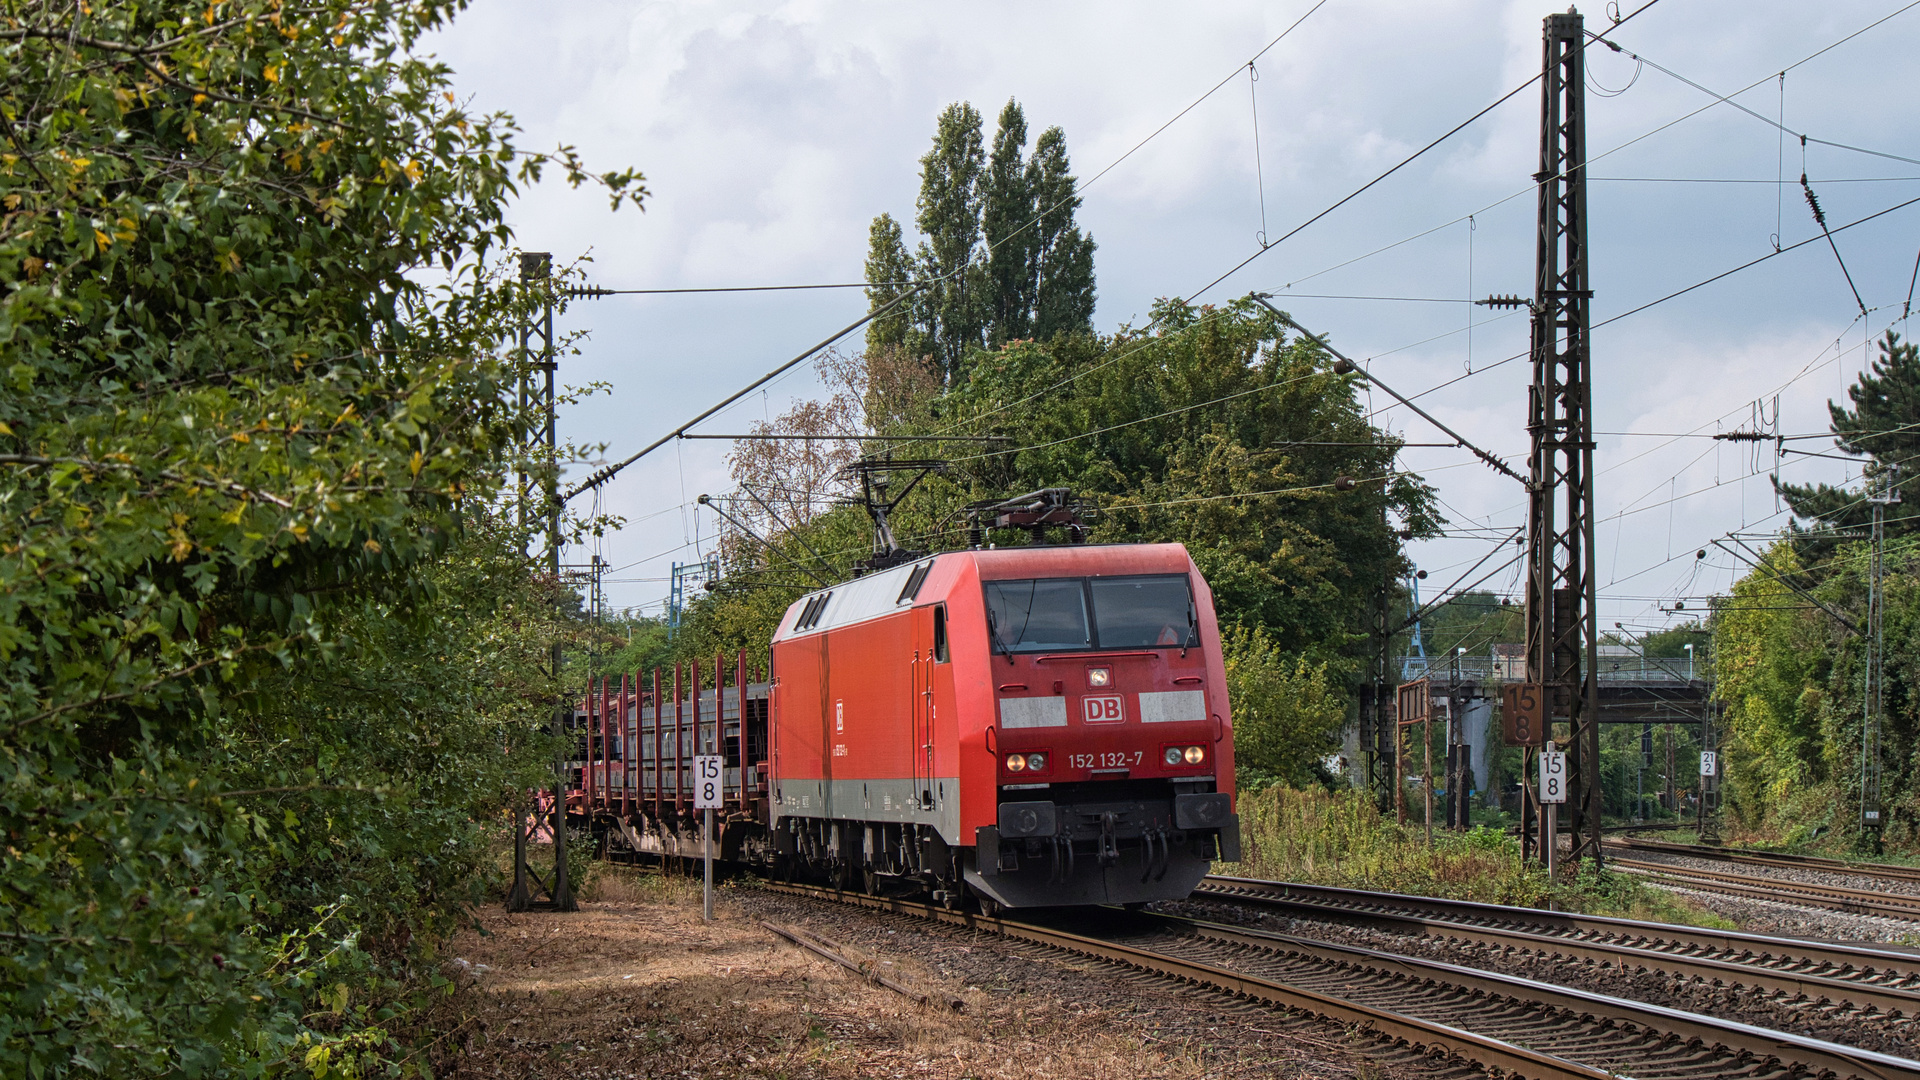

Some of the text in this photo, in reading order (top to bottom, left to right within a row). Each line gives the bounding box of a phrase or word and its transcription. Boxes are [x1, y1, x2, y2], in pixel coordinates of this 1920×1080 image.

[1509, 686, 1535, 712] 15
[1087, 698, 1120, 720] DB
[1515, 715, 1531, 741] 8
[1068, 751, 1143, 769] 152 132-7
[1543, 756, 1562, 774] 15
[1703, 752, 1714, 763] 21
[699, 760, 719, 779] 15
[1705, 763, 1711, 773] 2
[703, 782, 715, 801] 8
[1547, 777, 1559, 796] 8
